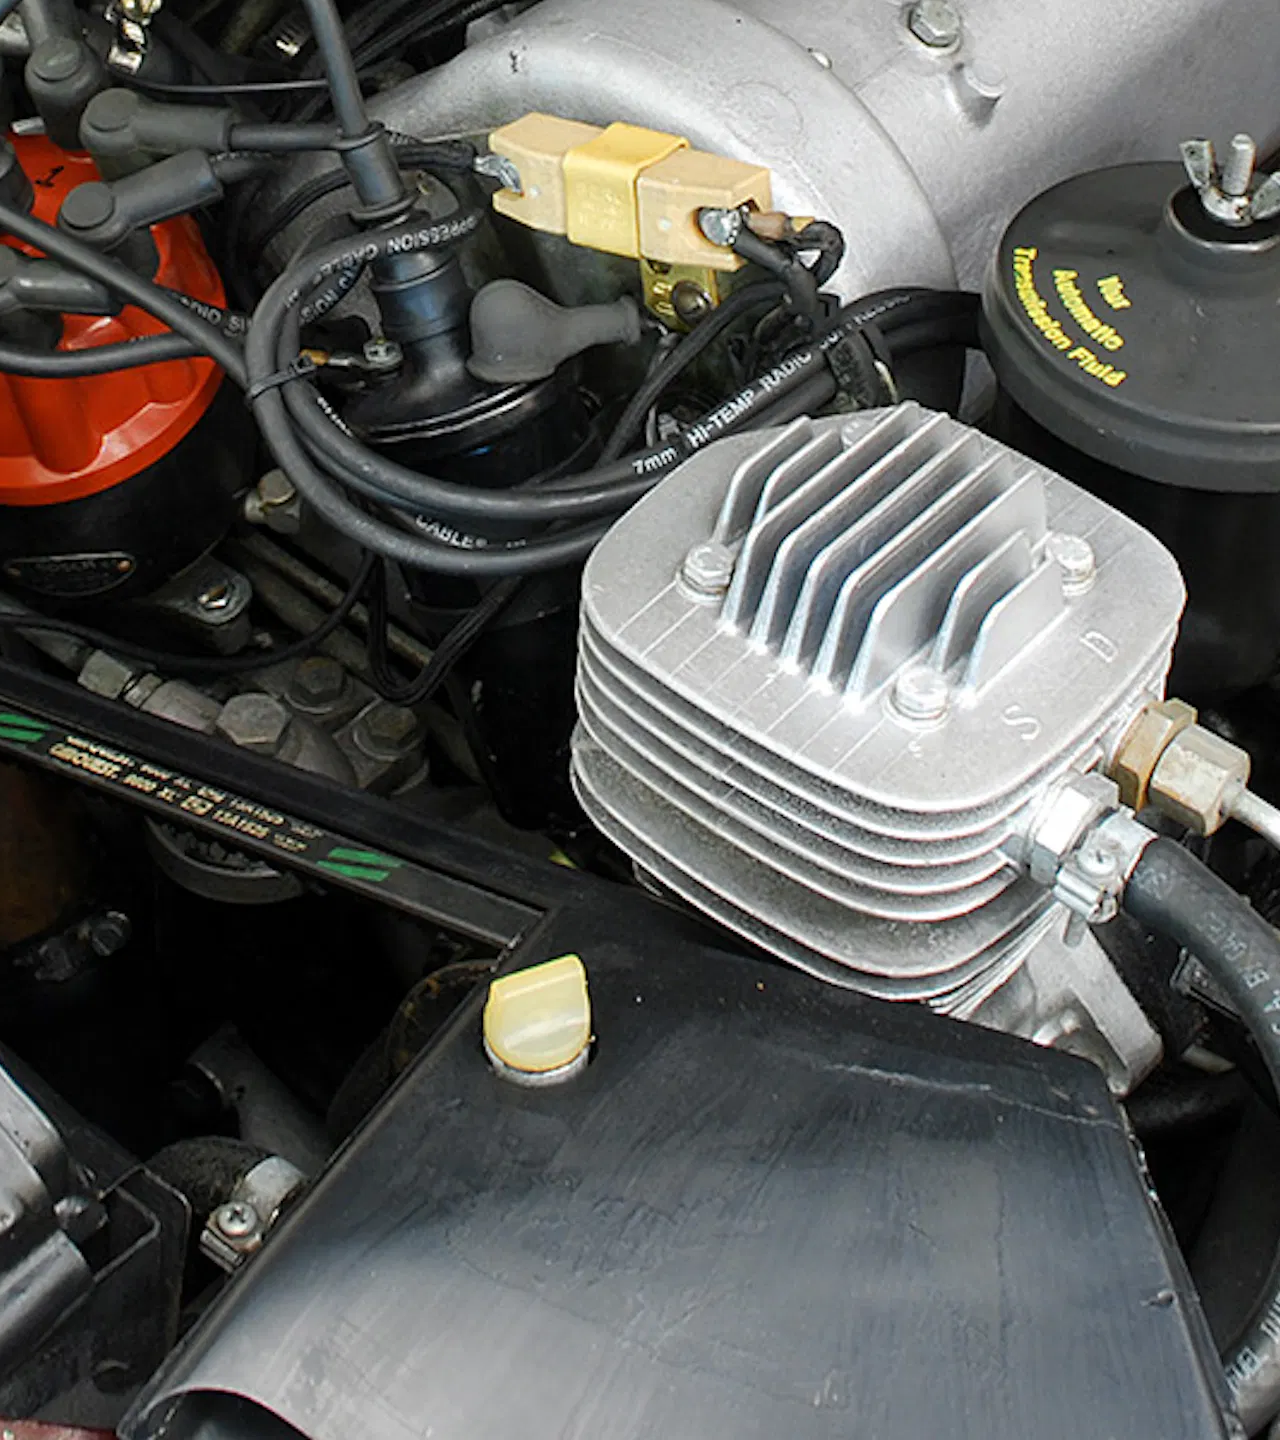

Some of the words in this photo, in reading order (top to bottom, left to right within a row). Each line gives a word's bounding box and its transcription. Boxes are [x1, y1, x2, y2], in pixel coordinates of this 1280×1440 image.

[1013, 246, 1073, 351] Transmission
[1066, 345, 1128, 388] Fluid
[1052, 269, 1125, 352] Automatic
[631, 447, 678, 474] 7mm
[686, 389, 755, 448] HI-TEMP
[1001, 704, 1042, 741] S
